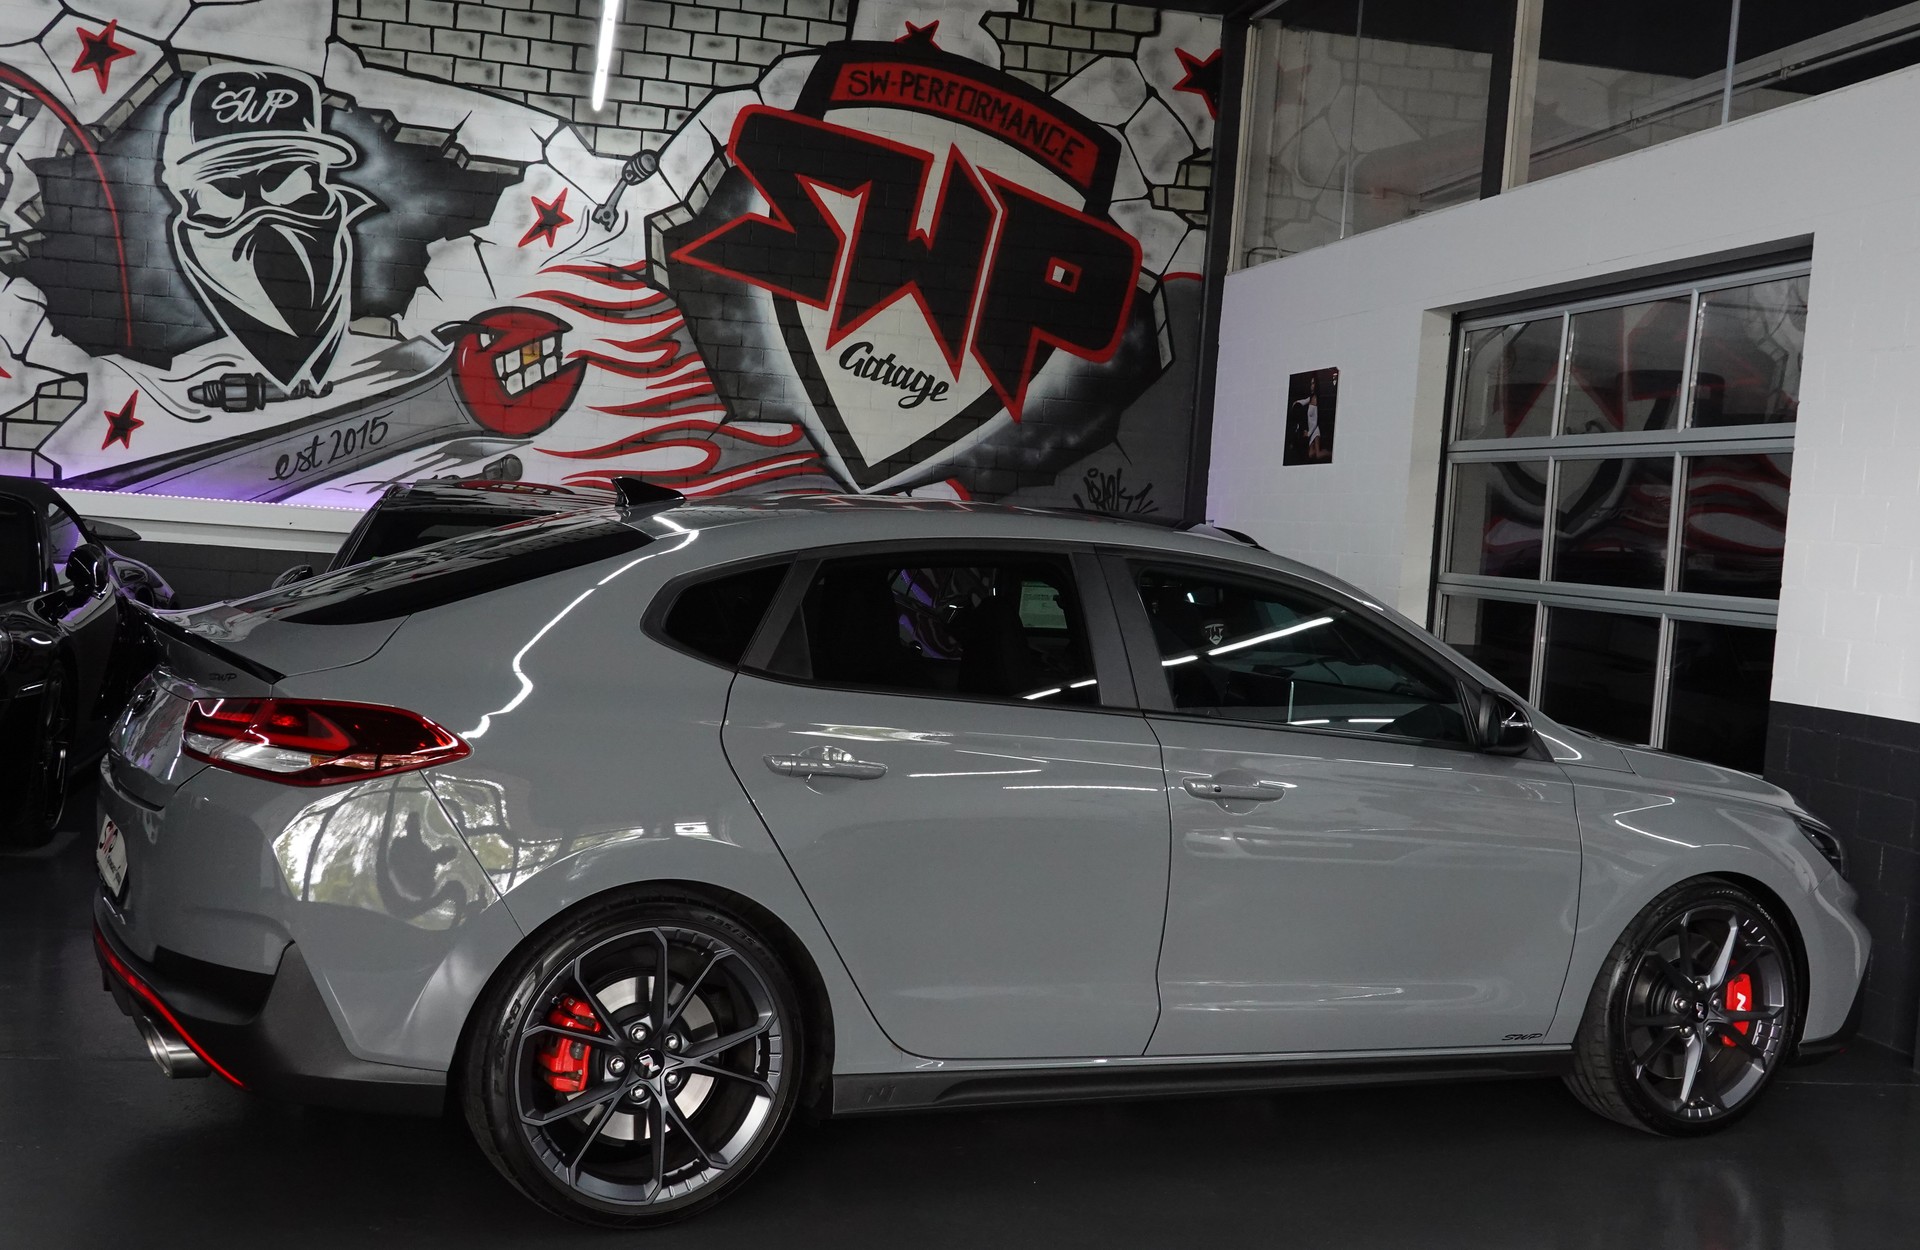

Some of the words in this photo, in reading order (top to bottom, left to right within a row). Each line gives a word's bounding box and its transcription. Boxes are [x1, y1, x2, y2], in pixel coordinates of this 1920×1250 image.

[211, 84, 300, 124] SWP
[847, 69, 1085, 170] SW-PERFORMANCE
[670, 103, 1143, 424] SWP
[838, 341, 950, 409] Garage
[268, 434, 326, 481] est
[327, 410, 394, 464] 2015
